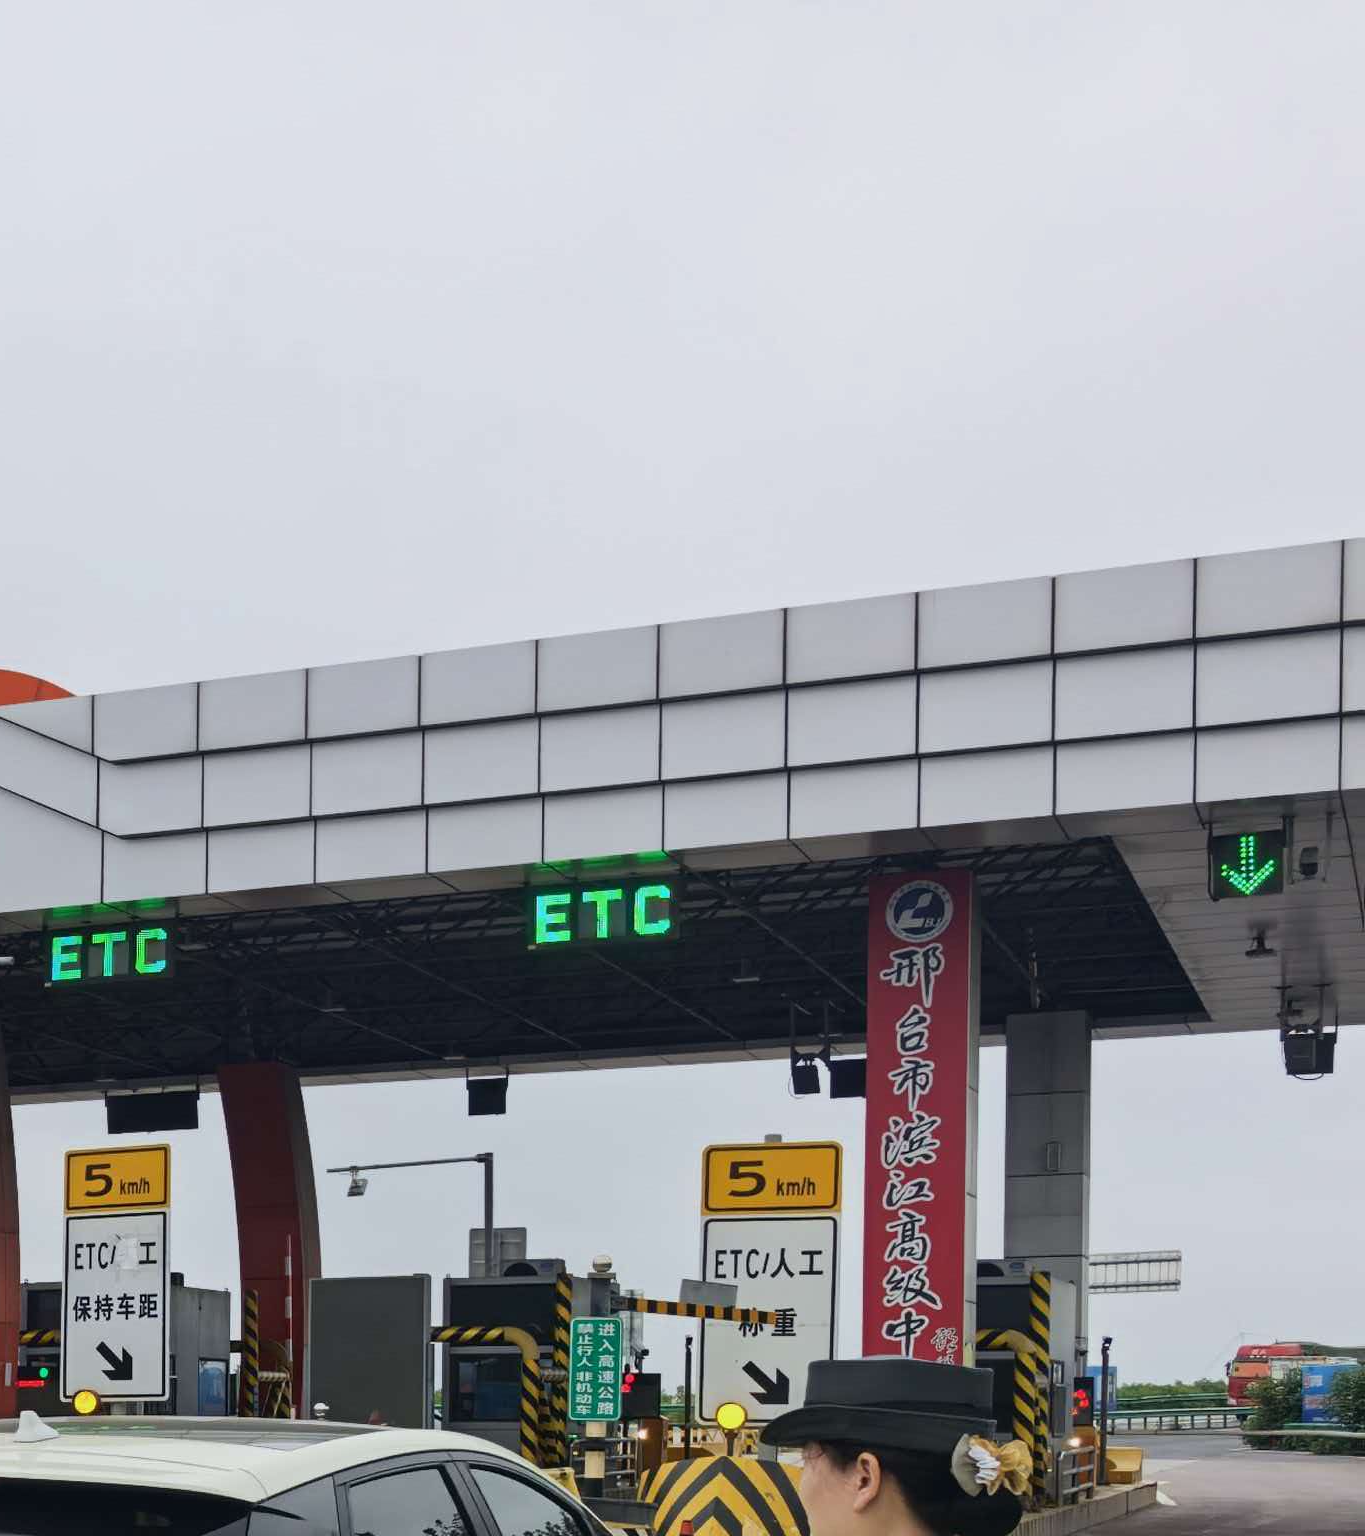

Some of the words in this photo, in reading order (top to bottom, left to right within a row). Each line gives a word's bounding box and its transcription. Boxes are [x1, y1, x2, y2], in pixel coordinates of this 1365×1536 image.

[535, 885, 671, 944] ETC
[51, 927, 167, 981] ETC
[84, 1163, 113, 1197] 5
[119, 1177, 150, 1196] km/h
[727, 1160, 767, 1198] 5
[775, 1177, 816, 1197] km/h
[74, 1240, 157, 1271] ETC/工
[714, 1247, 824, 1279] ETC/人工
[72, 1293, 159, 1322] 保持车距
[597, 1323, 616, 1415] 进入高速公路
[574, 1371, 594, 1415] 非机动车
